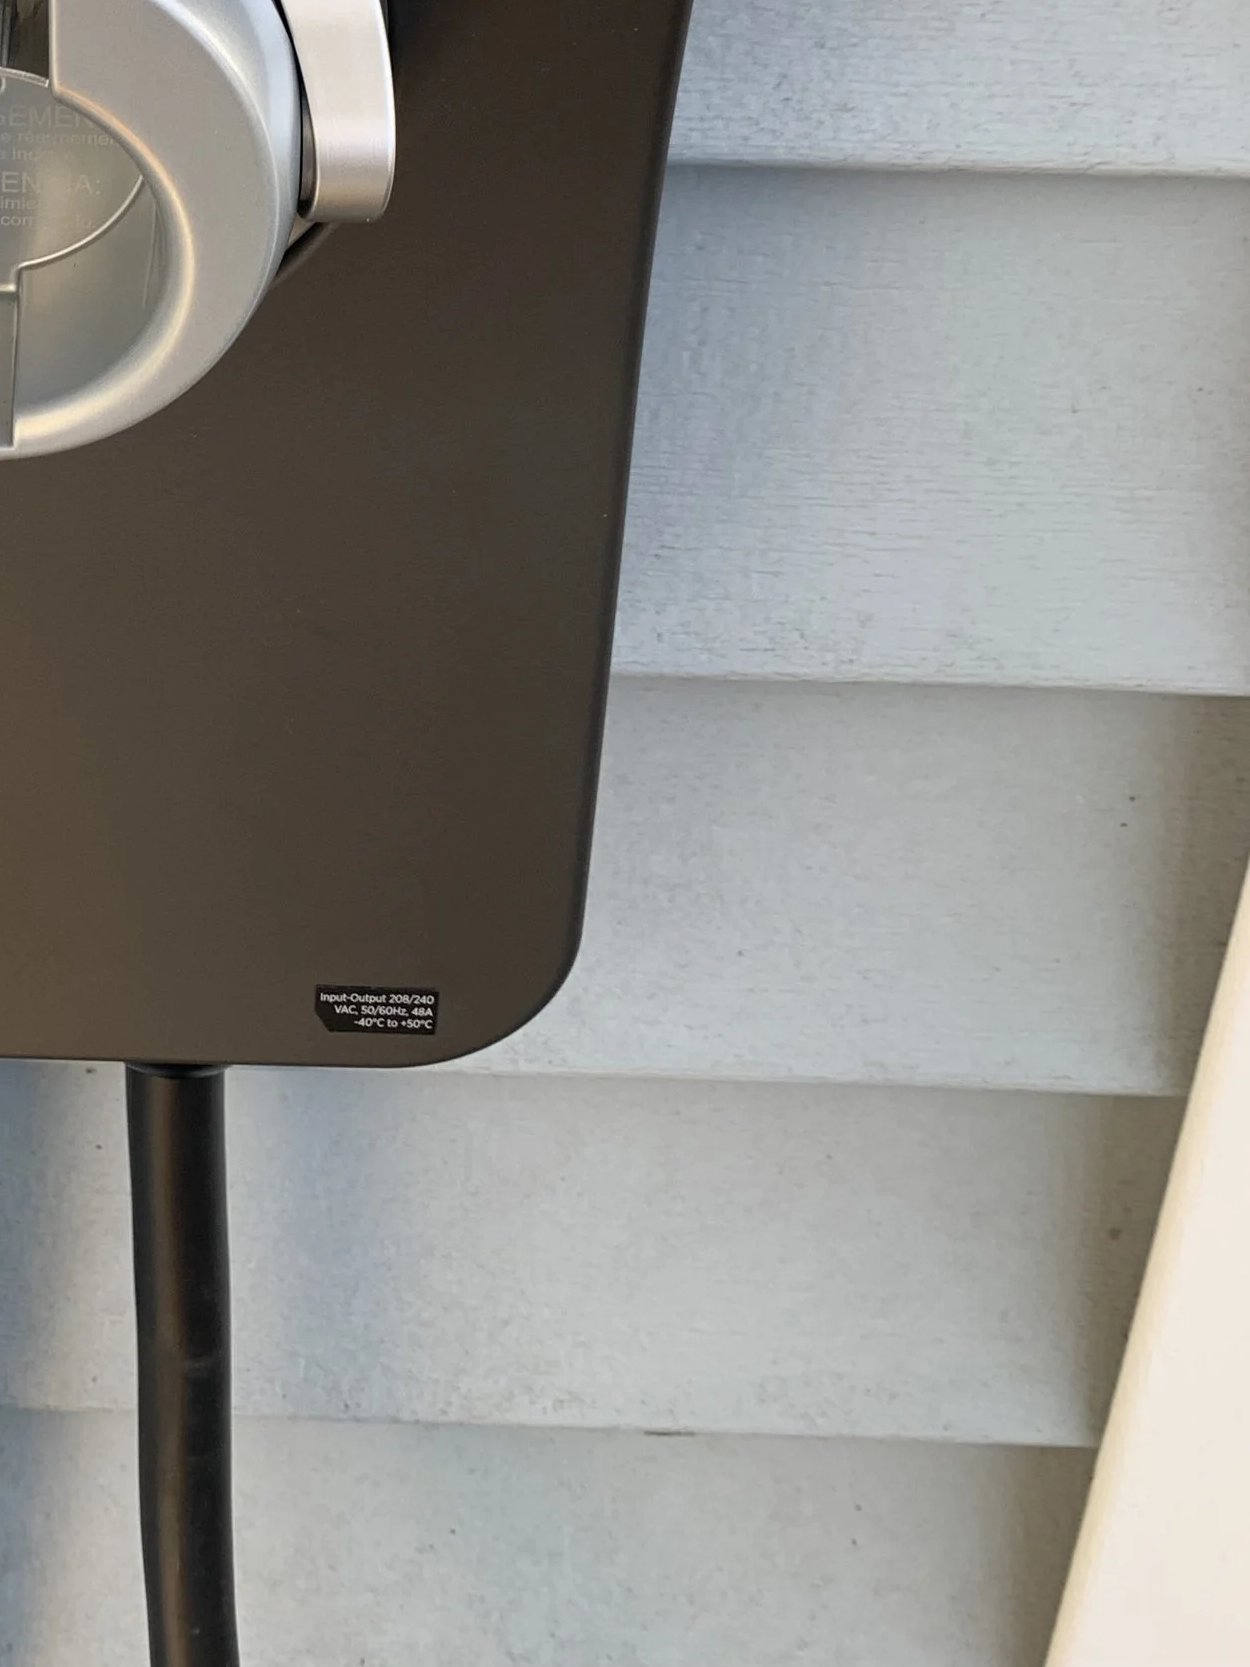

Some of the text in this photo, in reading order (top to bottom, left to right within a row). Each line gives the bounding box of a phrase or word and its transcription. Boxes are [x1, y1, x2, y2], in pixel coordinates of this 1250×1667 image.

[320, 992, 435, 1005] Input-Output 208/240
[334, 1005, 433, 1017] VAC, 50/60Hz, 48A
[387, 1018, 398, 1028] to
[401, 1019, 434, 1029] +50°C
